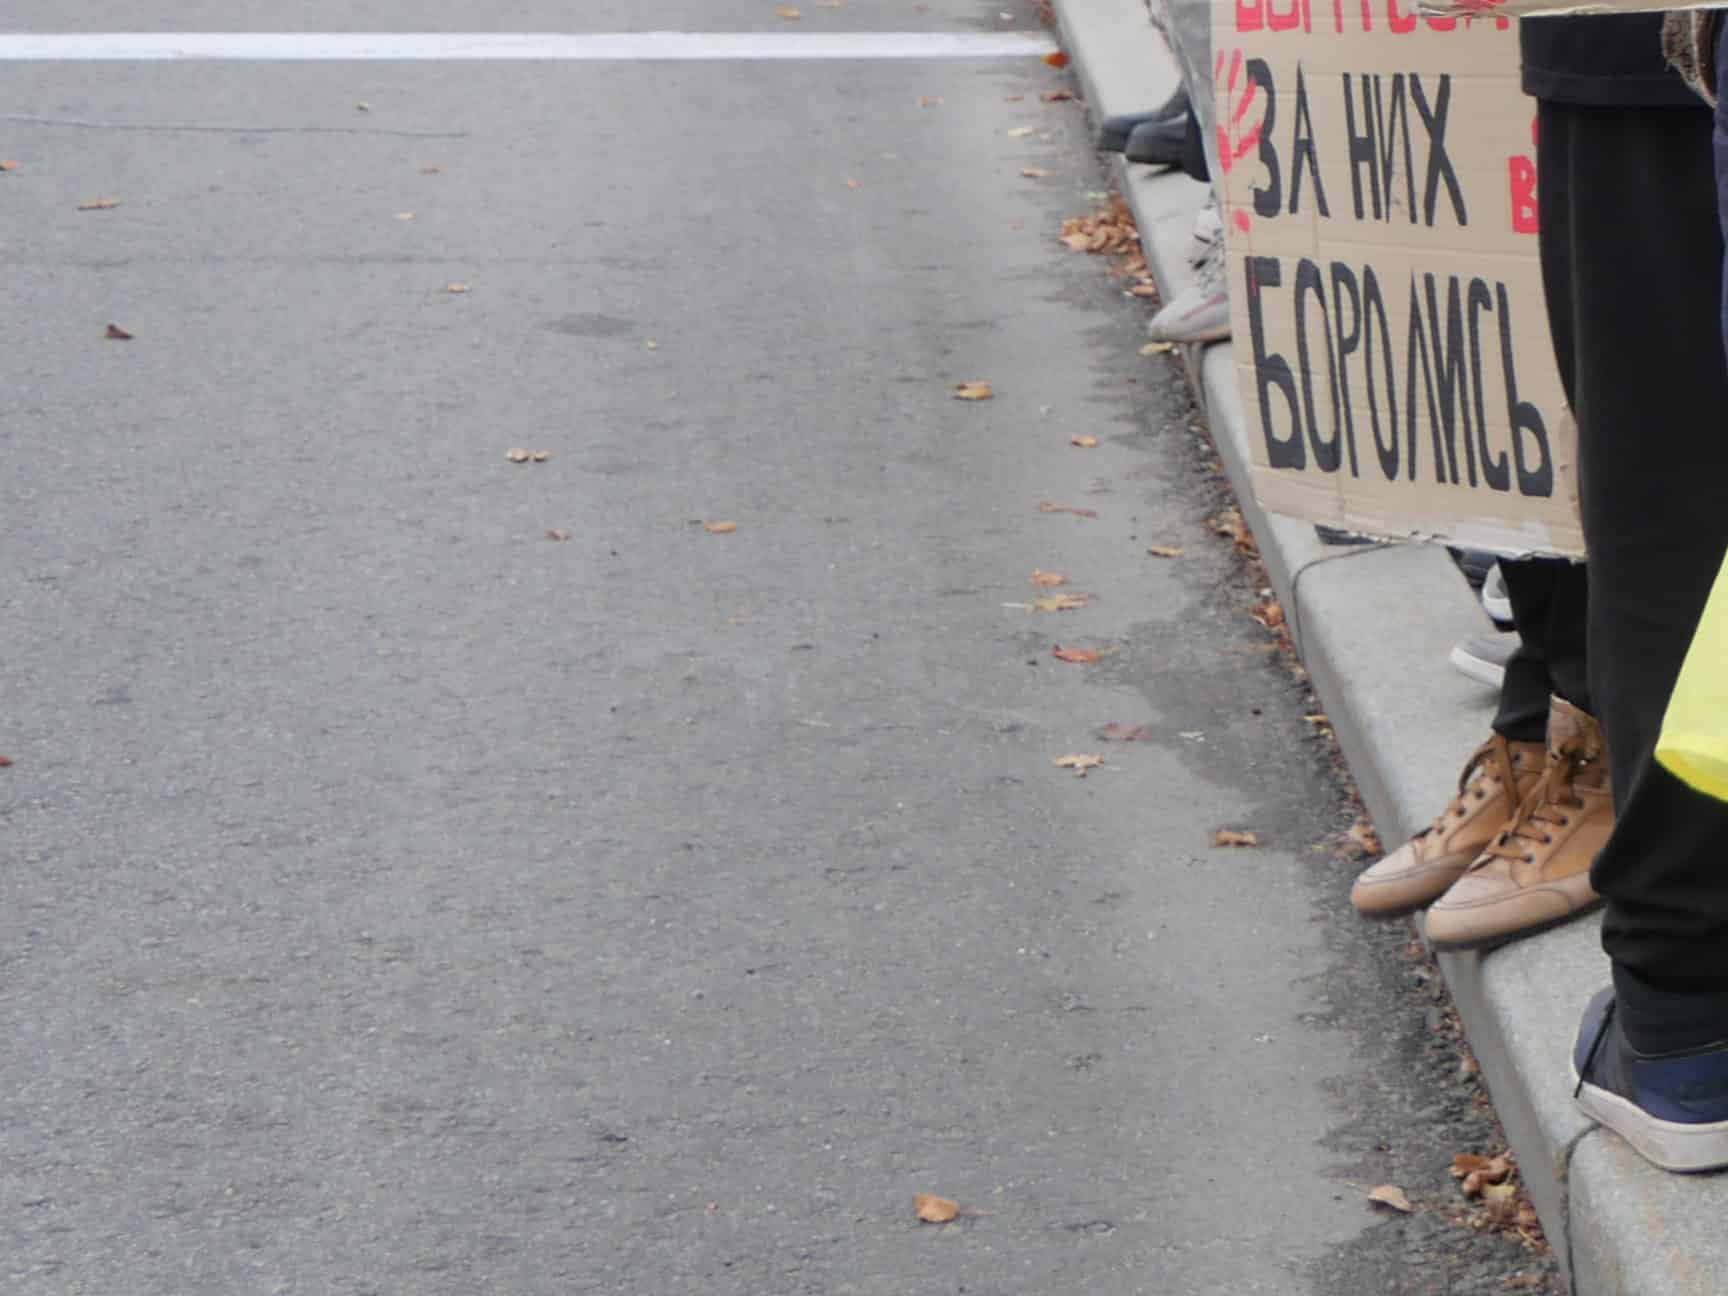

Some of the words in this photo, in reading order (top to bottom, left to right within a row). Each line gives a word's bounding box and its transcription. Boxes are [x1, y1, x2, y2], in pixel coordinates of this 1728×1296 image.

[1245, 56, 1330, 219] ЗА
[1342, 71, 1468, 228] НИХ
[1243, 256, 1554, 498] БОРОЛИСЬ
